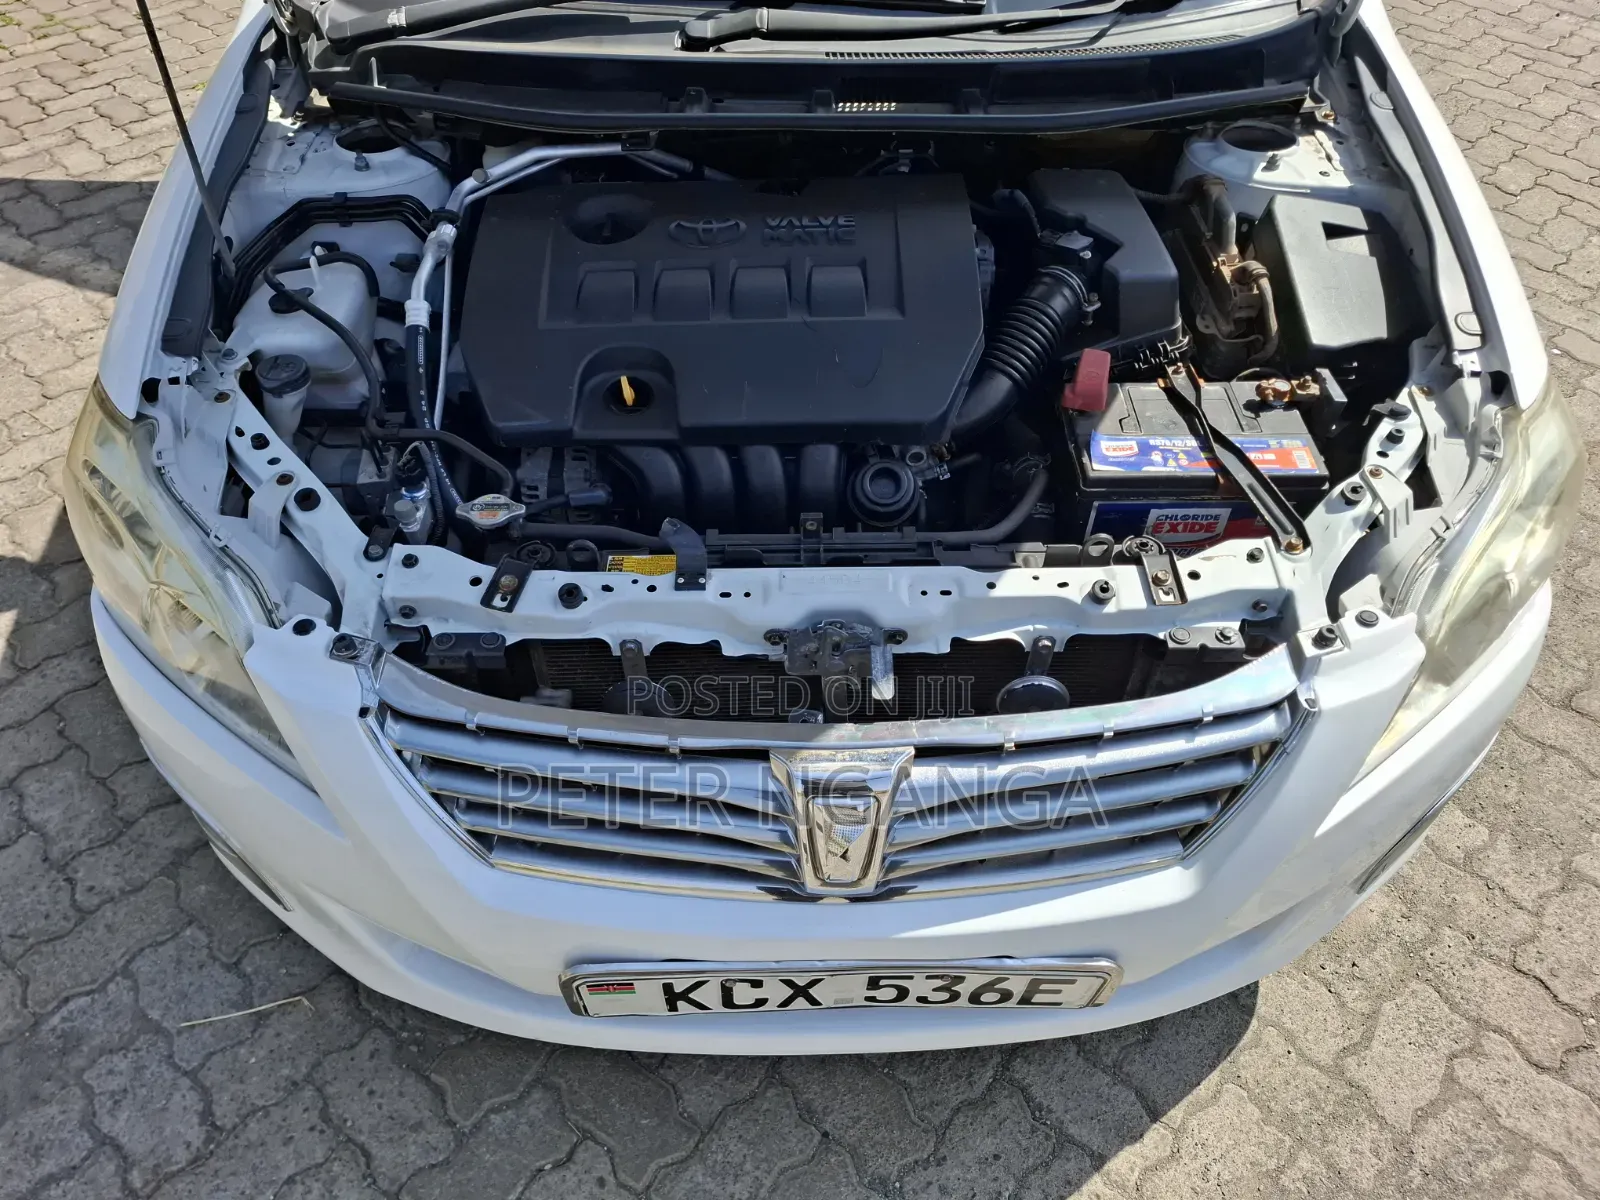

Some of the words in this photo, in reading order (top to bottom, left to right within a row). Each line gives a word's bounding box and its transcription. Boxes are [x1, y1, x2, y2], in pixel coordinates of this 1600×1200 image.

[765, 215, 855, 227] VALVE
[763, 228, 857, 246] MATIC
[1151, 521, 1219, 534] EXIDE
[661, 977, 824, 1013] KCX
[863, 974, 1079, 1007] 536E
